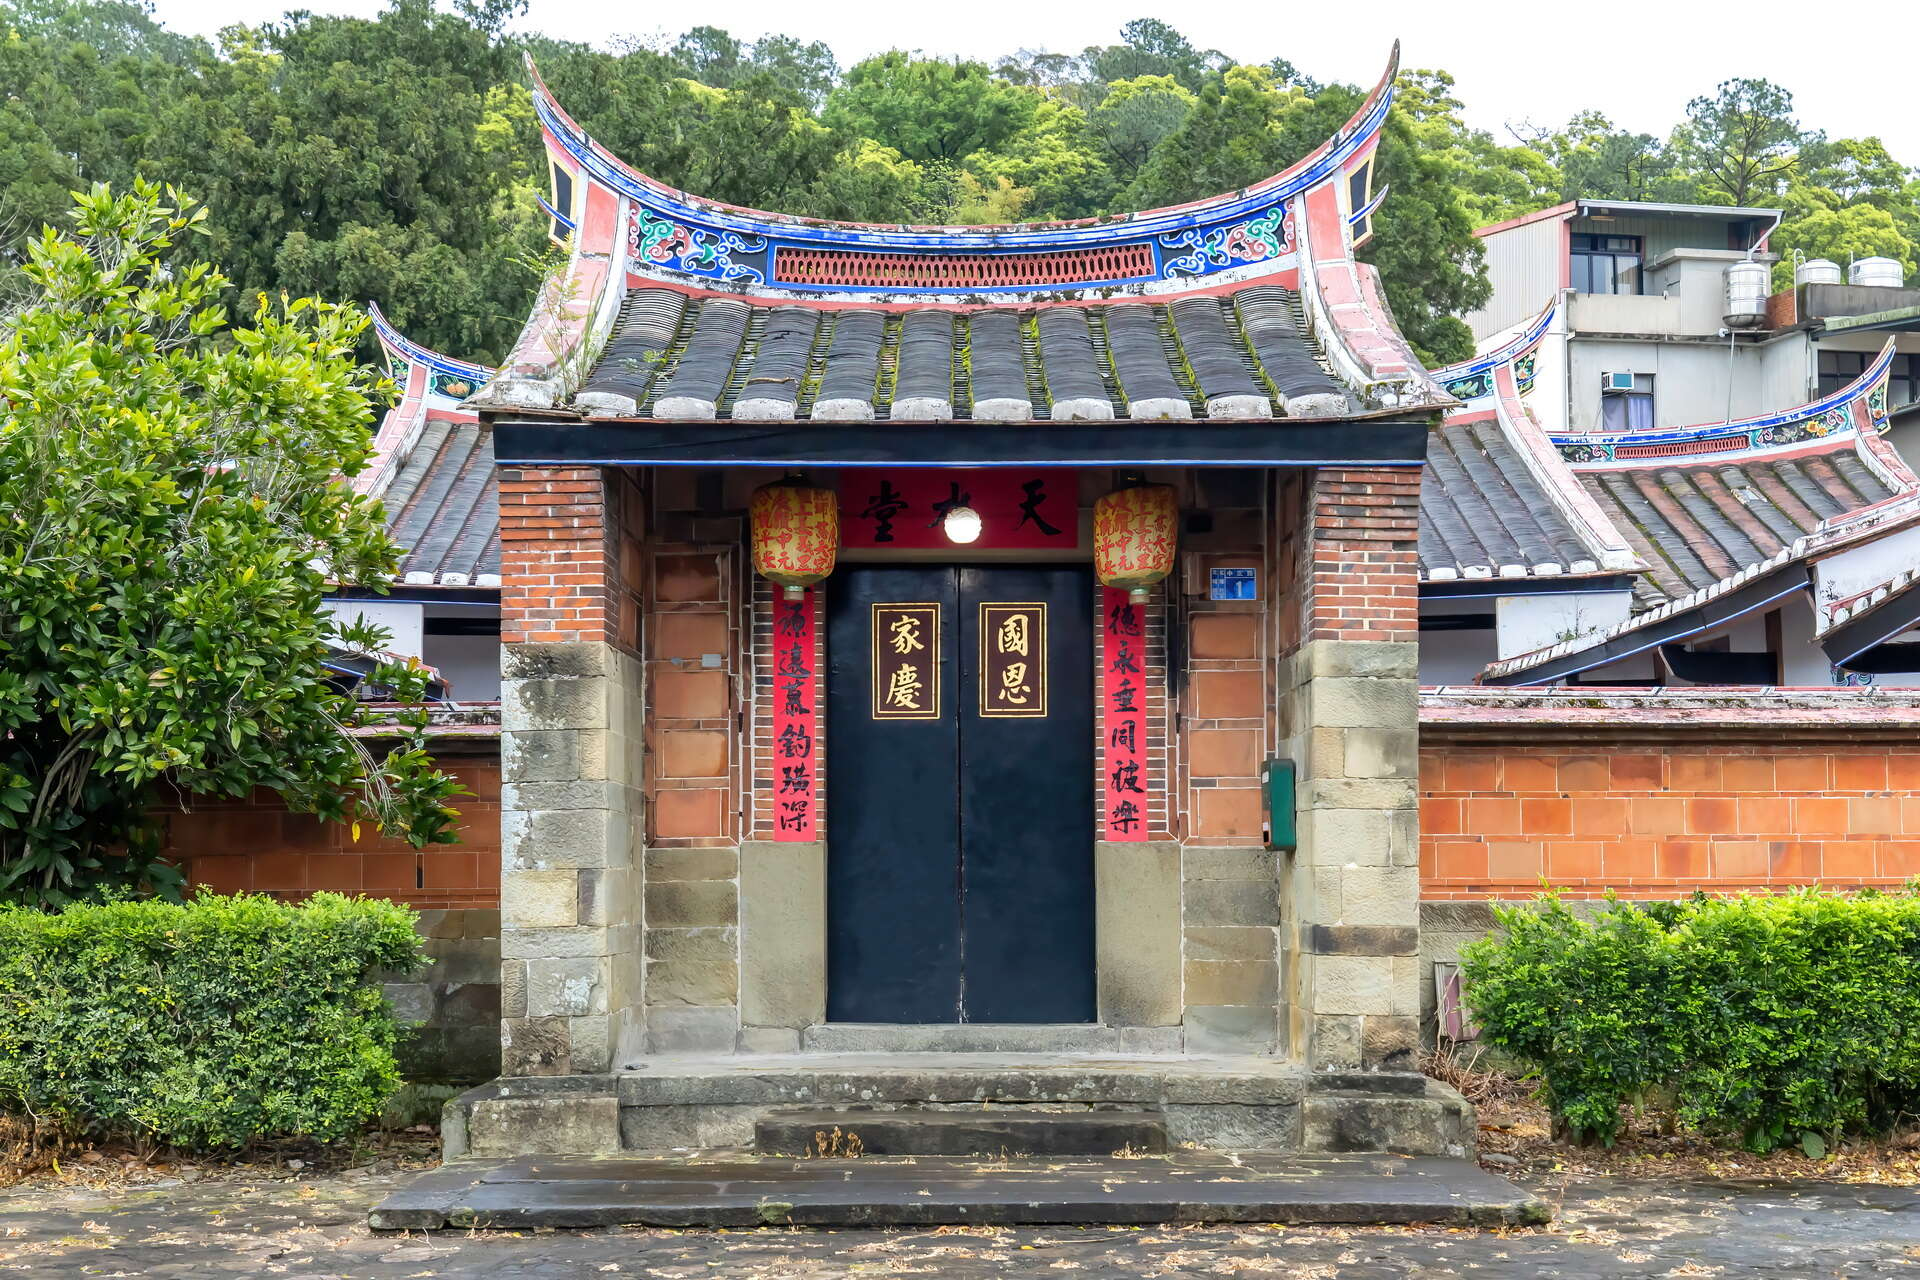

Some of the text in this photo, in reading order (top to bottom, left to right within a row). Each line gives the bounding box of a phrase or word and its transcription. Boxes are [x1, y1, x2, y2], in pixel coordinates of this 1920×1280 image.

[1235, 580, 1243, 598] 1
[886, 614, 925, 709] 家慶
[998, 614, 1031, 704] 國恩
[1108, 590, 1145, 834] 德永垂同被樂
